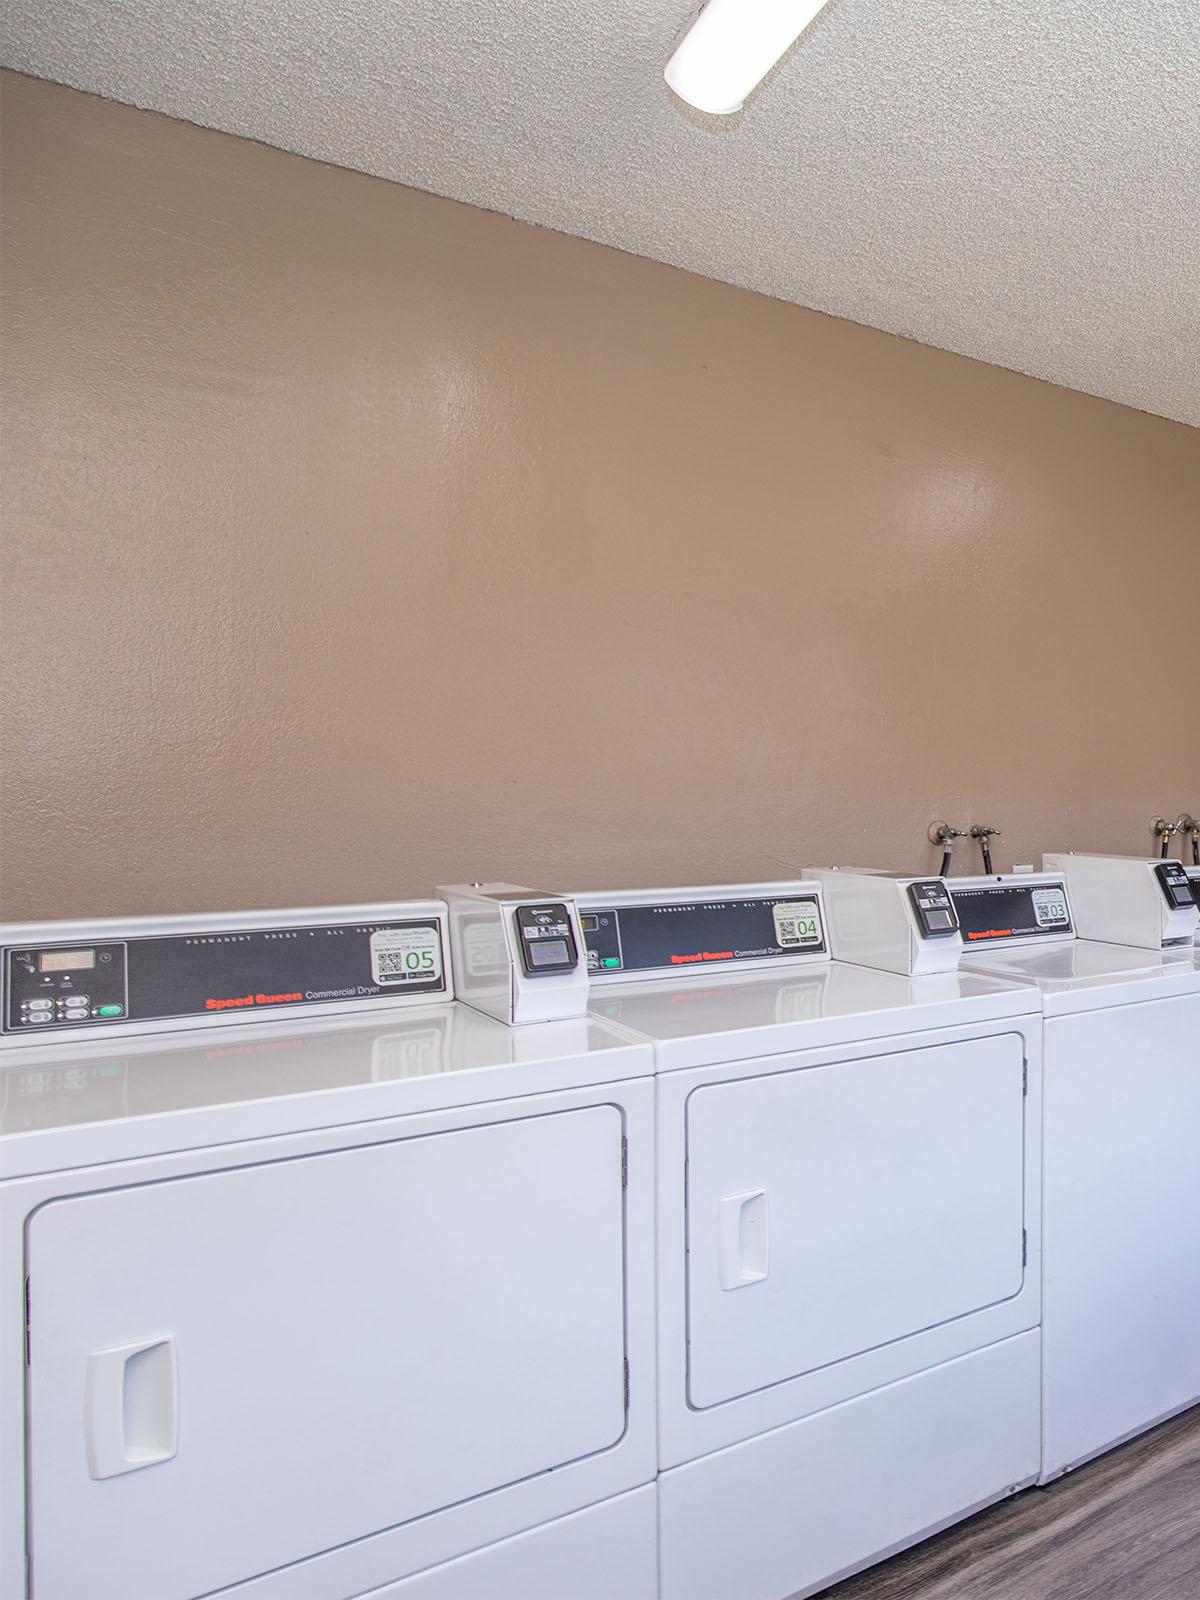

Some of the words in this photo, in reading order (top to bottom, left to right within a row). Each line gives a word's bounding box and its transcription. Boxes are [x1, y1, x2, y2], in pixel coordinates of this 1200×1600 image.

[653, 905, 696, 913] PERMANENT
[1050, 904, 1065, 917] 03
[798, 921, 817, 935] 04
[968, 931, 991, 939] Speed
[990, 929, 1012, 937] Queen
[186, 935, 252, 945] PERMANENT
[265, 932, 298, 940] PRESS
[406, 951, 434, 969] 05
[671, 953, 702, 965] Speed
[704, 950, 733, 961] Queen
[735, 946, 767, 957] Commercial
[768, 946, 784, 955] Dryer
[206, 995, 254, 1011] Speed
[255, 992, 303, 1005] Queen
[305, 988, 356, 1000] Commercial
[358, 985, 380, 997] Dryer
